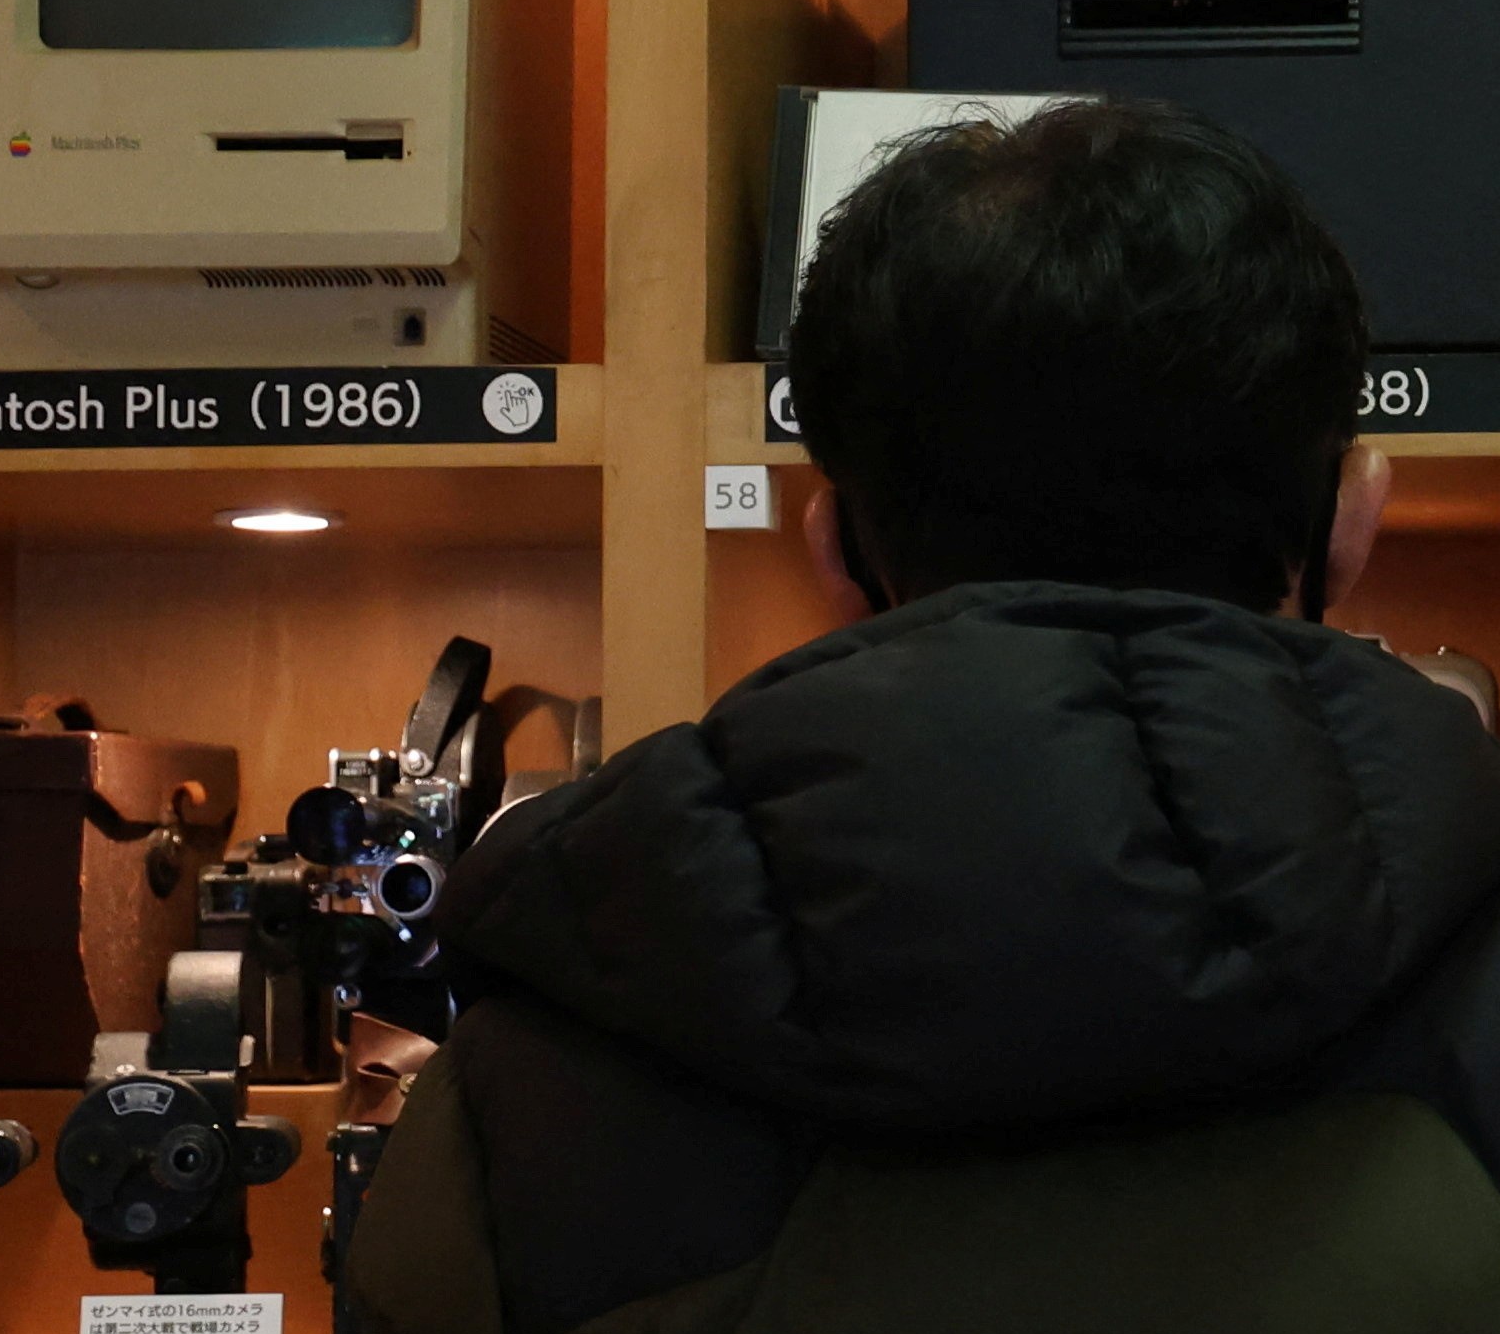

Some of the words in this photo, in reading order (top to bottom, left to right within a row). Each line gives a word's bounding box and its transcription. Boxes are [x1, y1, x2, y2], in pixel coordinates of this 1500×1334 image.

[125, 384, 220, 430] Plus
[249, 378, 422, 430] (1986)
[714, 481, 758, 511] 58
